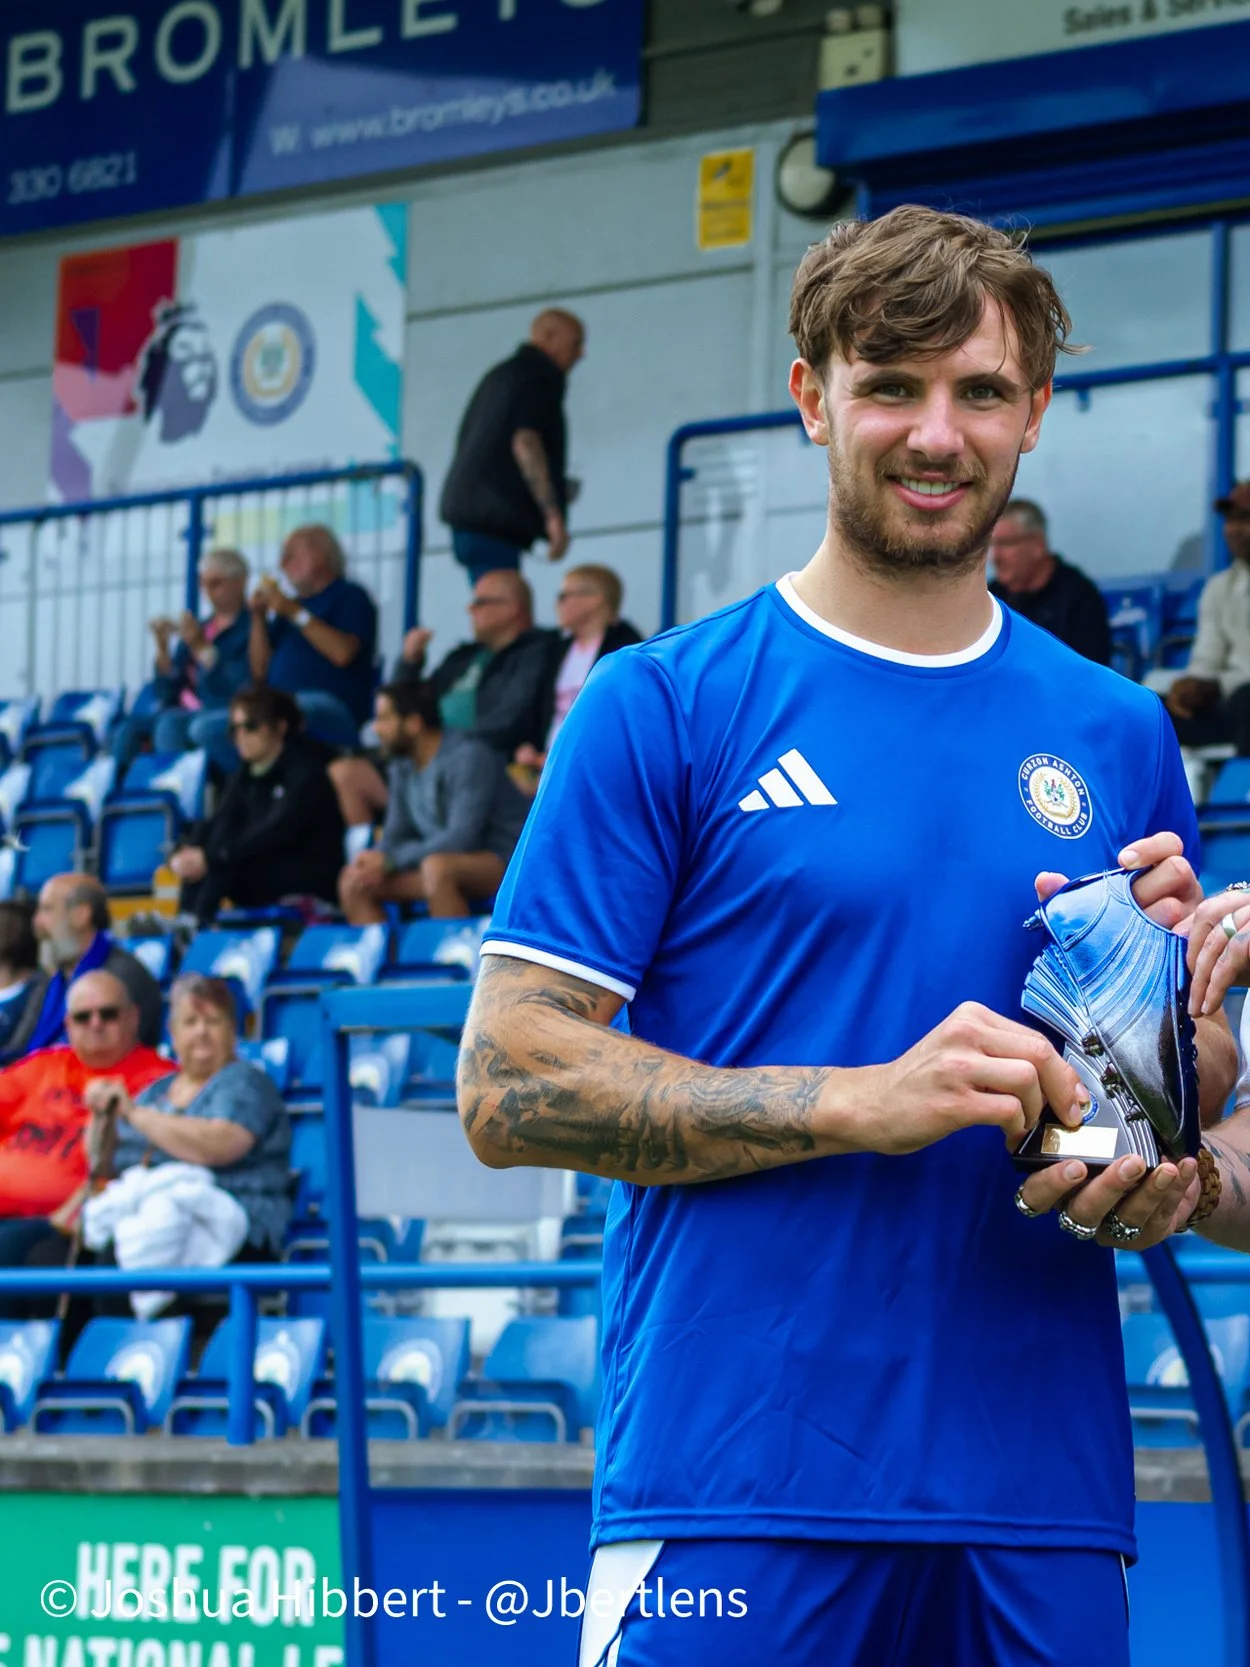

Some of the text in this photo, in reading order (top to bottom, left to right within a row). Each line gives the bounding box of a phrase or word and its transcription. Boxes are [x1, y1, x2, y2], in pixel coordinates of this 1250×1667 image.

[5, 0, 608, 114] BROMLE
[1021, 757, 1049, 780] CURZON
[1052, 760, 1085, 796] ASHTON
[1026, 799, 1071, 835] FOOTBALL
[1072, 812, 1088, 833] CLUB
[75, 1542, 316, 1628] HERE FOR
